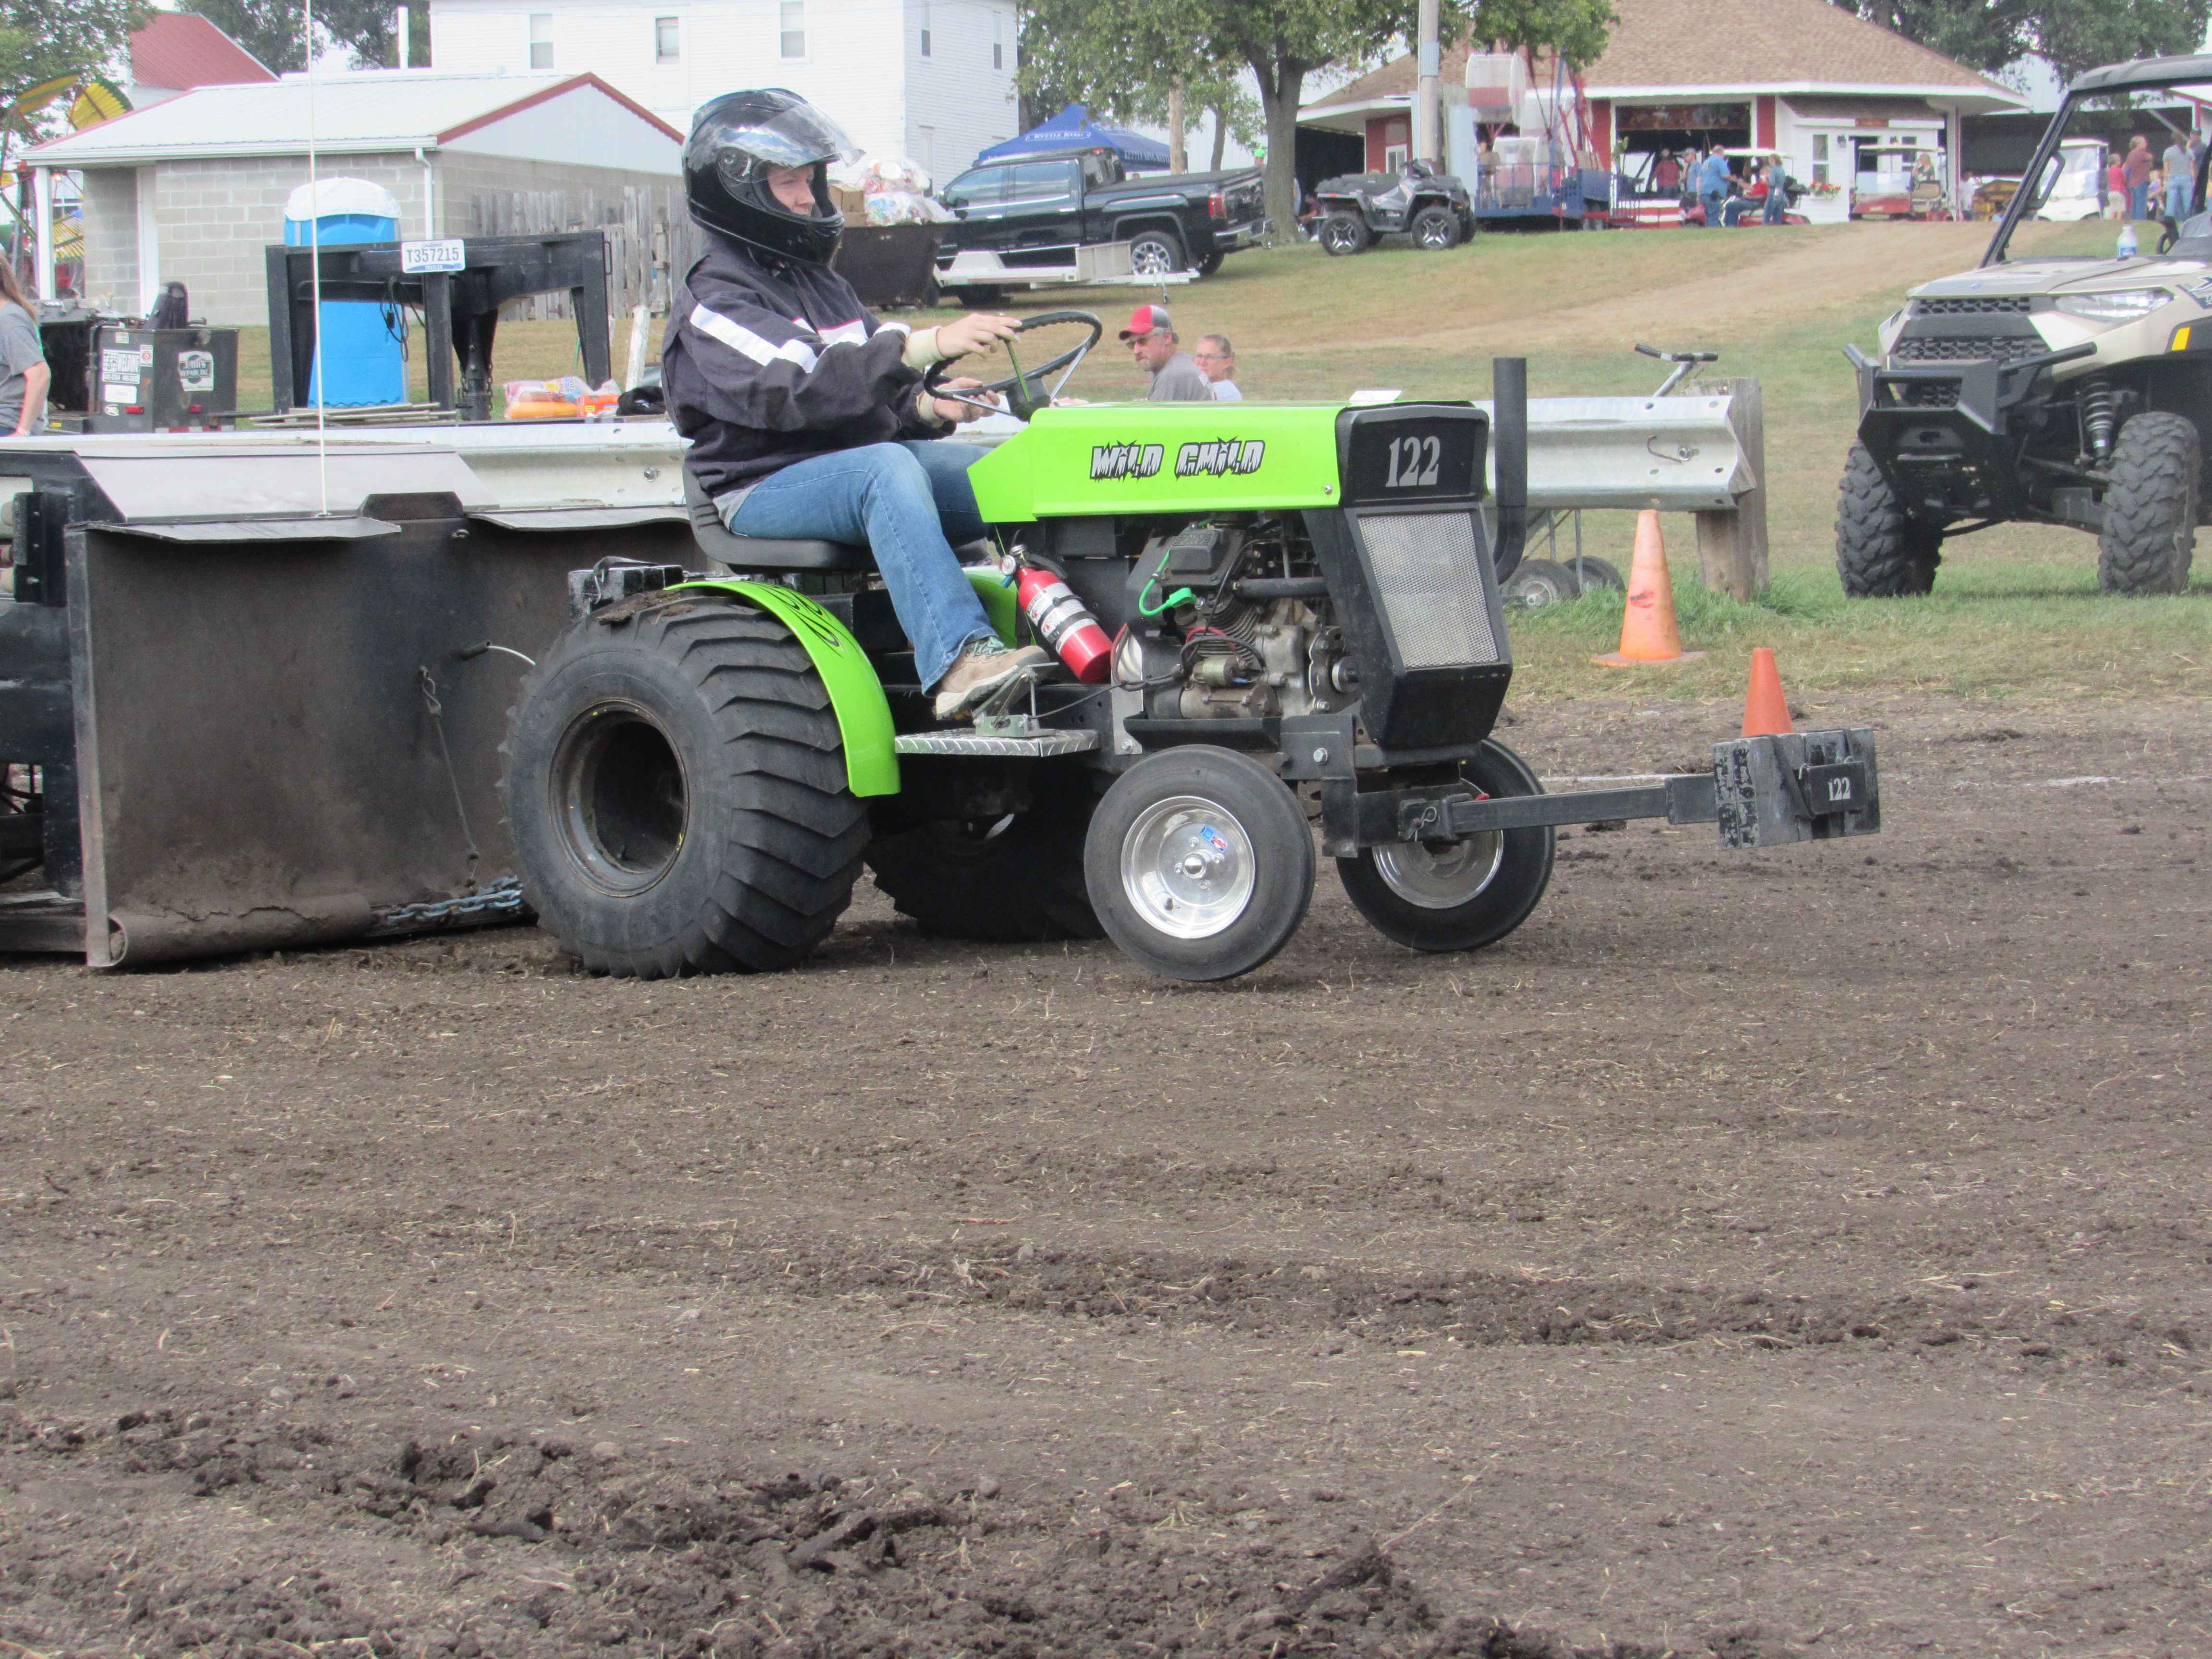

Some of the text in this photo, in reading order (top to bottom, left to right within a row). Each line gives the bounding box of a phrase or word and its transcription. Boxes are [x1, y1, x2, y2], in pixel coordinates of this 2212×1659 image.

[407, 247, 459, 263] T357215
[1385, 436, 1440, 487] 122
[1827, 777, 1851, 801] 122
